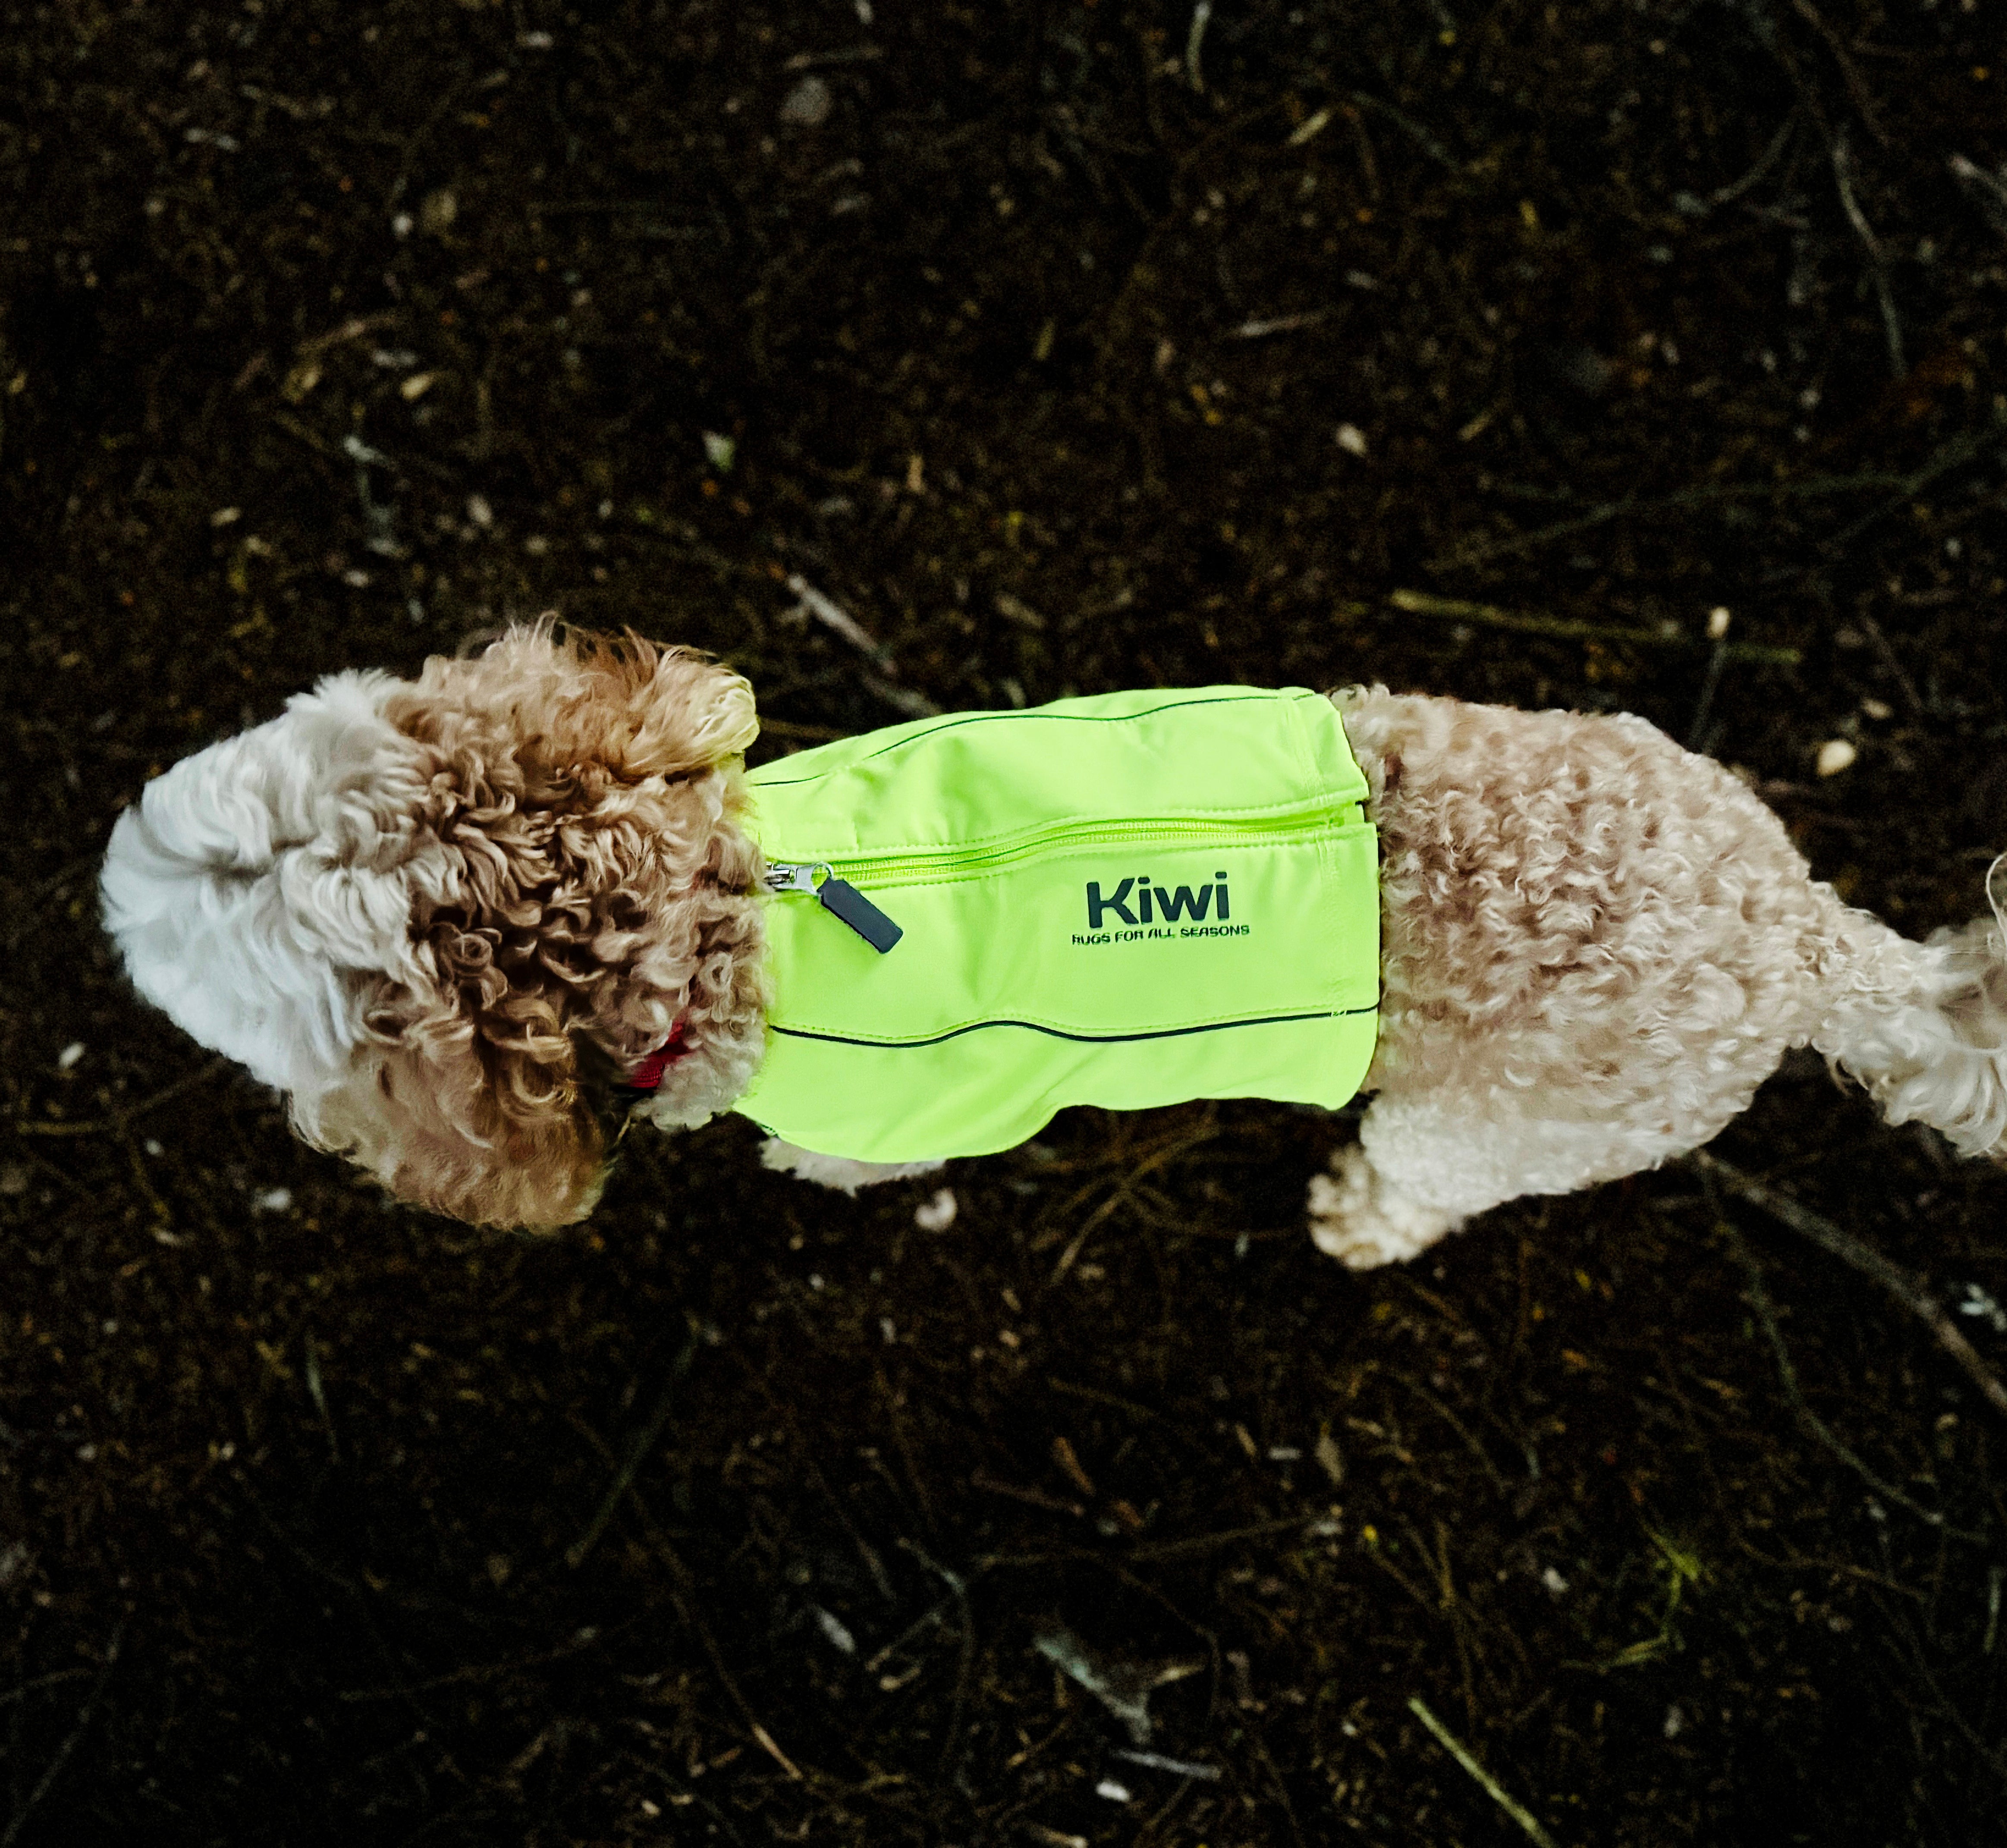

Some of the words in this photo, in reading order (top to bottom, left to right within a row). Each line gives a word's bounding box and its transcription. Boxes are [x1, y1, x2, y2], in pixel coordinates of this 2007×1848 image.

[1086, 871, 1230, 929] Kiwi
[1072, 933, 1111, 945] RUGS
[1115, 930, 1143, 943] FOR
[1148, 928, 1175, 940] ALL
[1180, 925, 1250, 937] SEASONS
